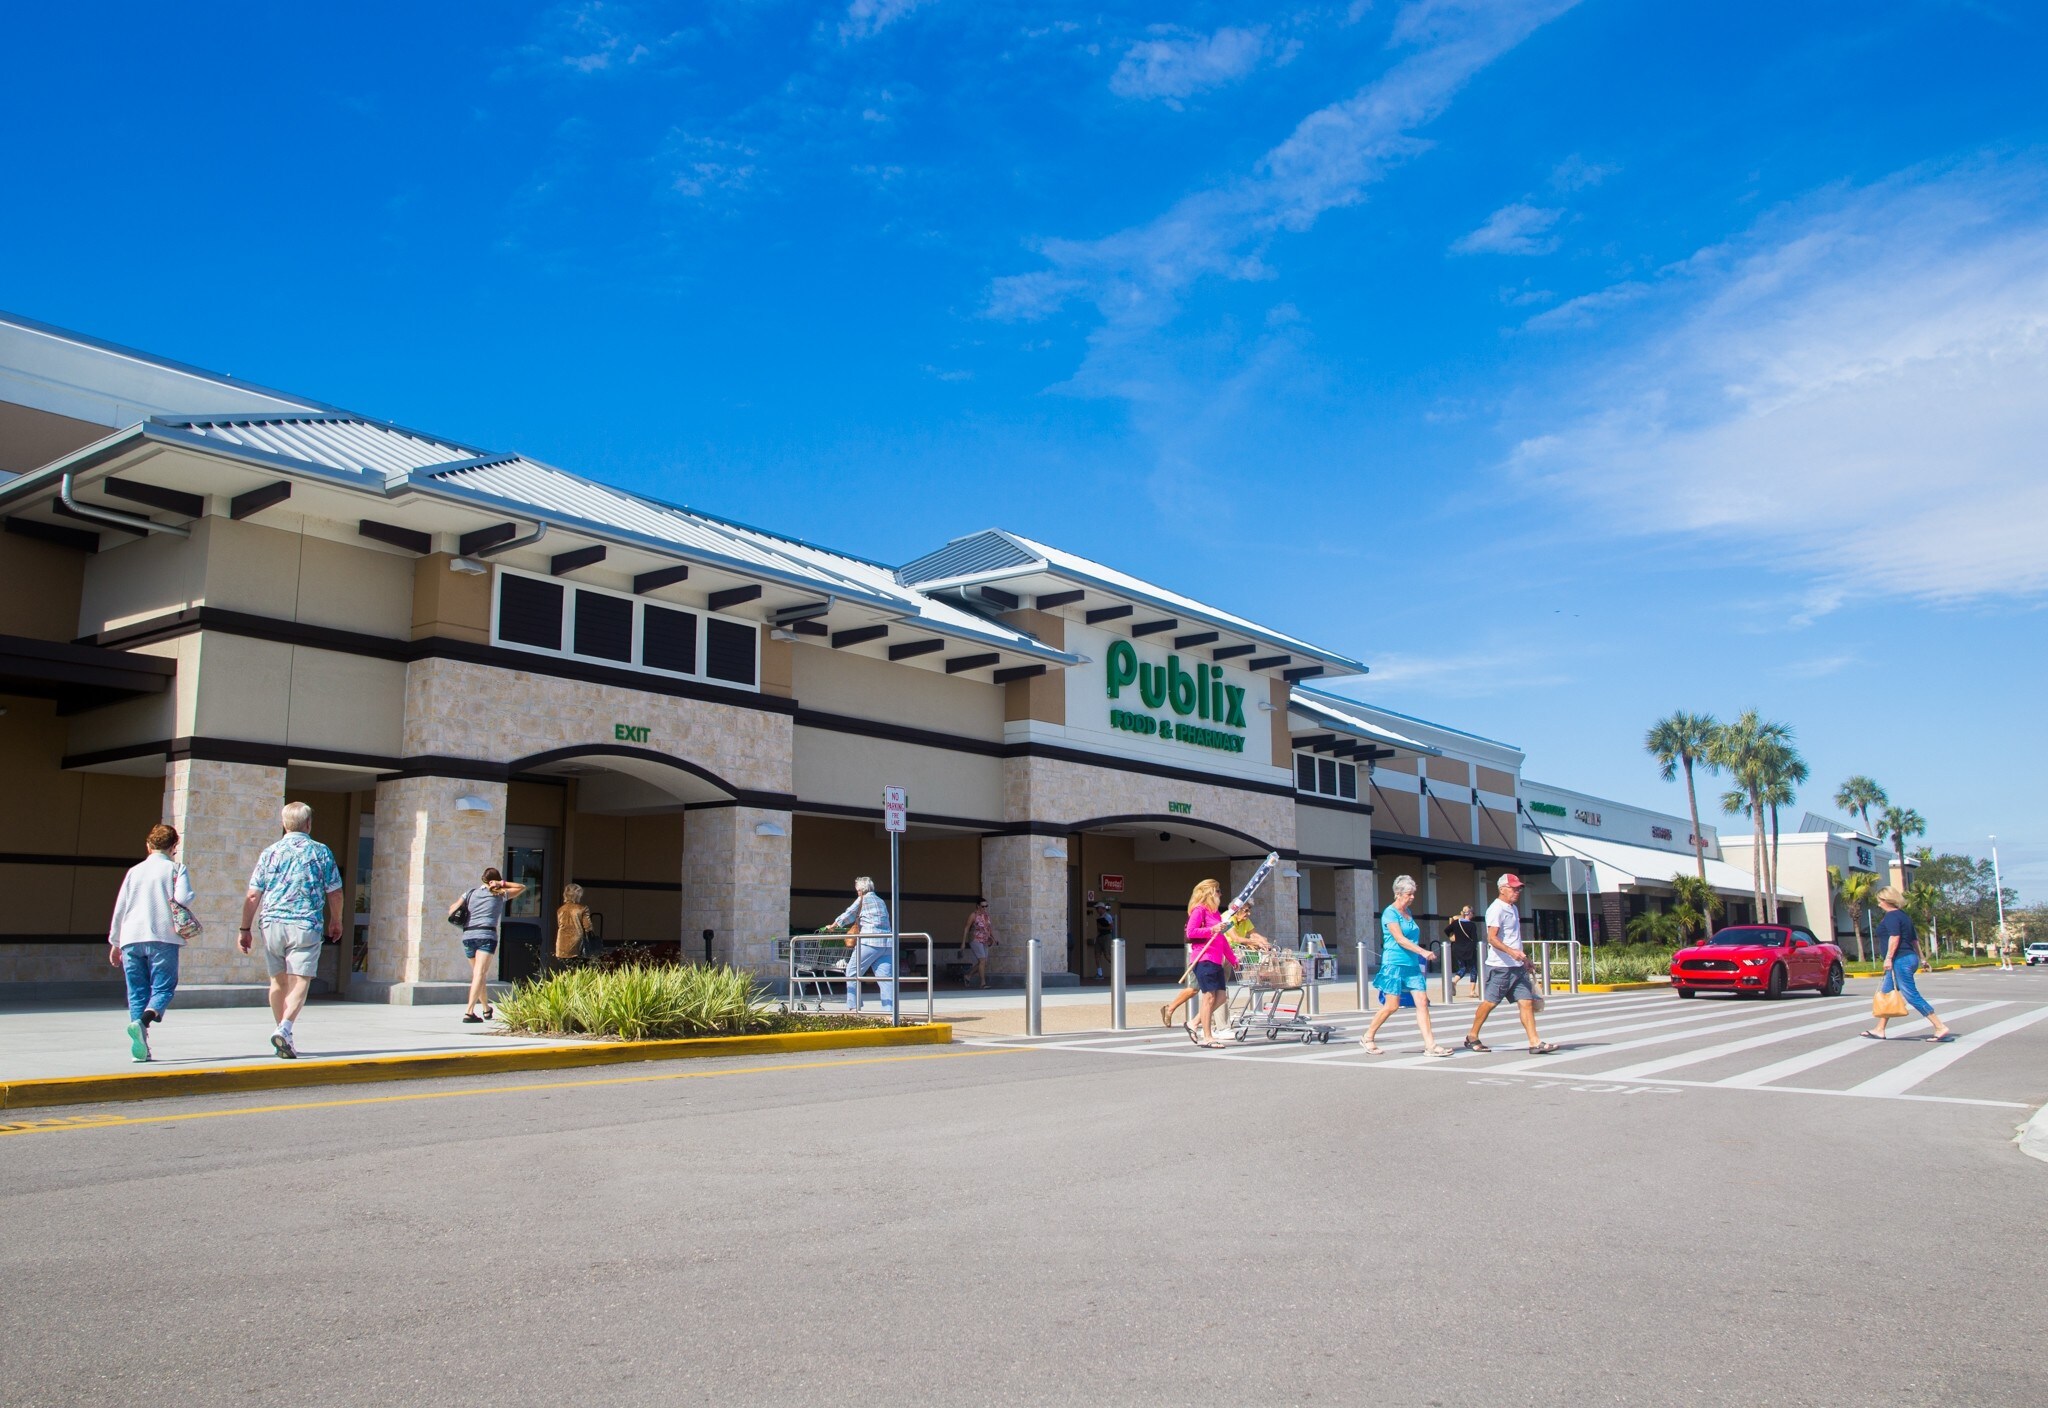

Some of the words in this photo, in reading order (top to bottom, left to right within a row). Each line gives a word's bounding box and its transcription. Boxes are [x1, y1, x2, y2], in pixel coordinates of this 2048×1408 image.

[1107, 640, 1246, 728] Publix
[615, 723, 652, 743] EXIT
[1111, 710, 1157, 735] FOOD
[1159, 720, 1174, 739] &
[1175, 723, 1246, 753] PHARMACY
[891, 792, 899, 801] NO
[887, 802, 904, 812] PARKING
[1168, 801, 1192, 814] ENTRY
[1467, 1077, 1684, 1095] STOP
